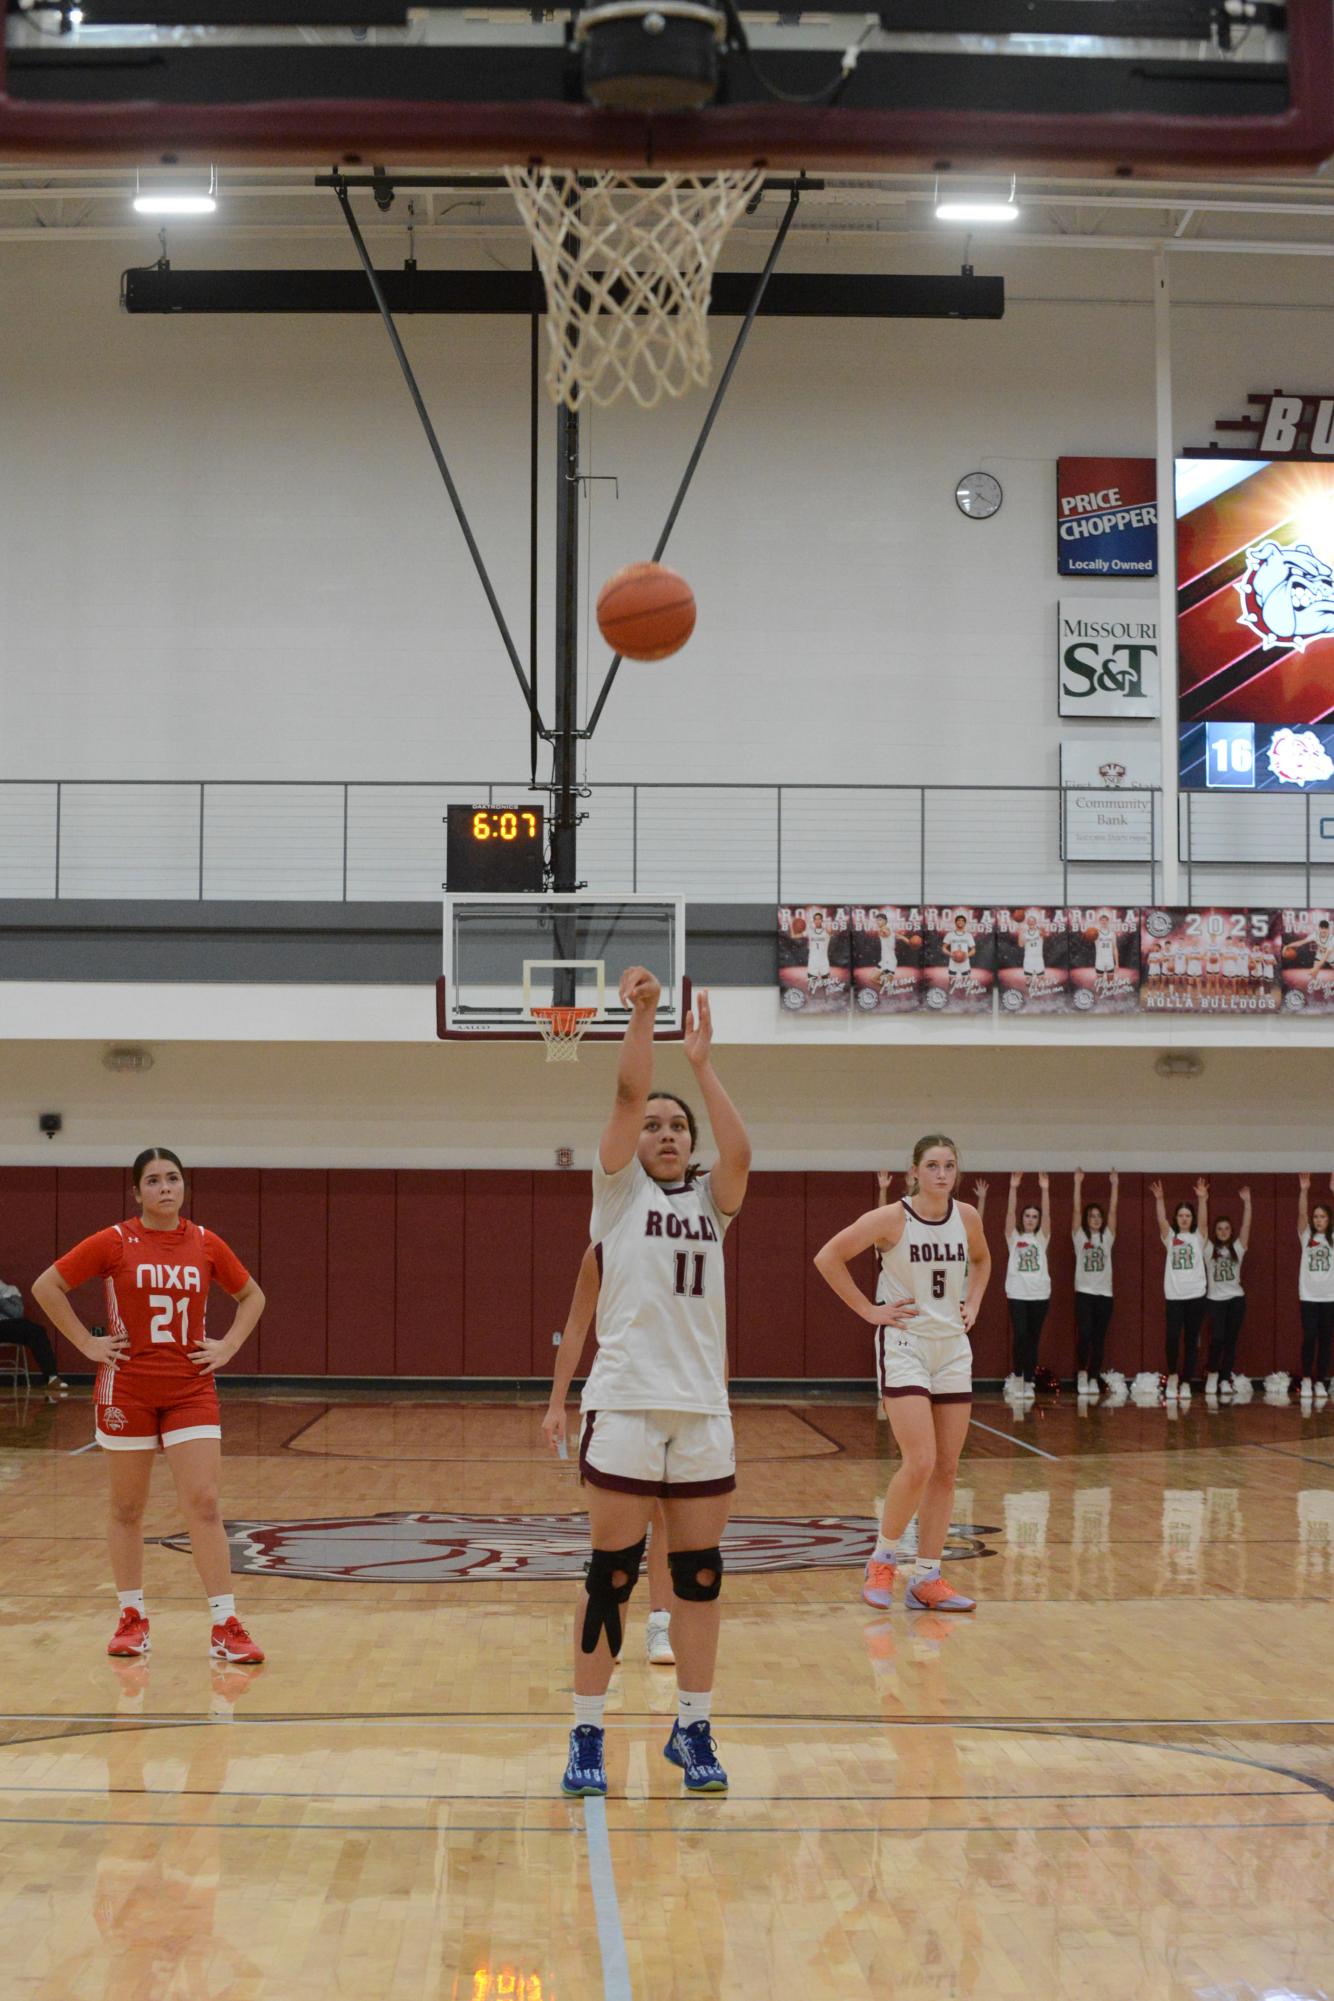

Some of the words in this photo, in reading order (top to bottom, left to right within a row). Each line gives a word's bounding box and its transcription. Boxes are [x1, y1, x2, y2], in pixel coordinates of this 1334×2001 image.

[1062, 488, 1122, 515] PRICE
[1060, 507, 1158, 540] CHOPPER
[1069, 559, 1109, 572] Locally
[1112, 559, 1153, 570] Owned
[1063, 619, 1157, 639] MISSOURI
[1063, 642, 1158, 698] S&T
[1211, 738, 1253, 773] 16
[1075, 796, 1148, 811] Community
[473, 813, 536, 839] 6:07
[1097, 814, 1128, 826] Bank
[782, 908, 846, 922] ROLA
[855, 908, 920, 922] ROLA
[928, 908, 992, 923] ROLA
[1072, 909, 1137, 923] ROLA
[1185, 913, 1269, 938] 2025
[1147, 998, 1193, 1008] ROLLA
[1201, 998, 1276, 1009] BULLDOGS
[645, 1209, 718, 1242] ROLL
[910, 1243, 966, 1263] ROLLA
[137, 1264, 200, 1293] NIXA
[673, 1249, 707, 1298] 11
[931, 1268, 947, 1299] 5
[149, 1294, 190, 1346] 21
